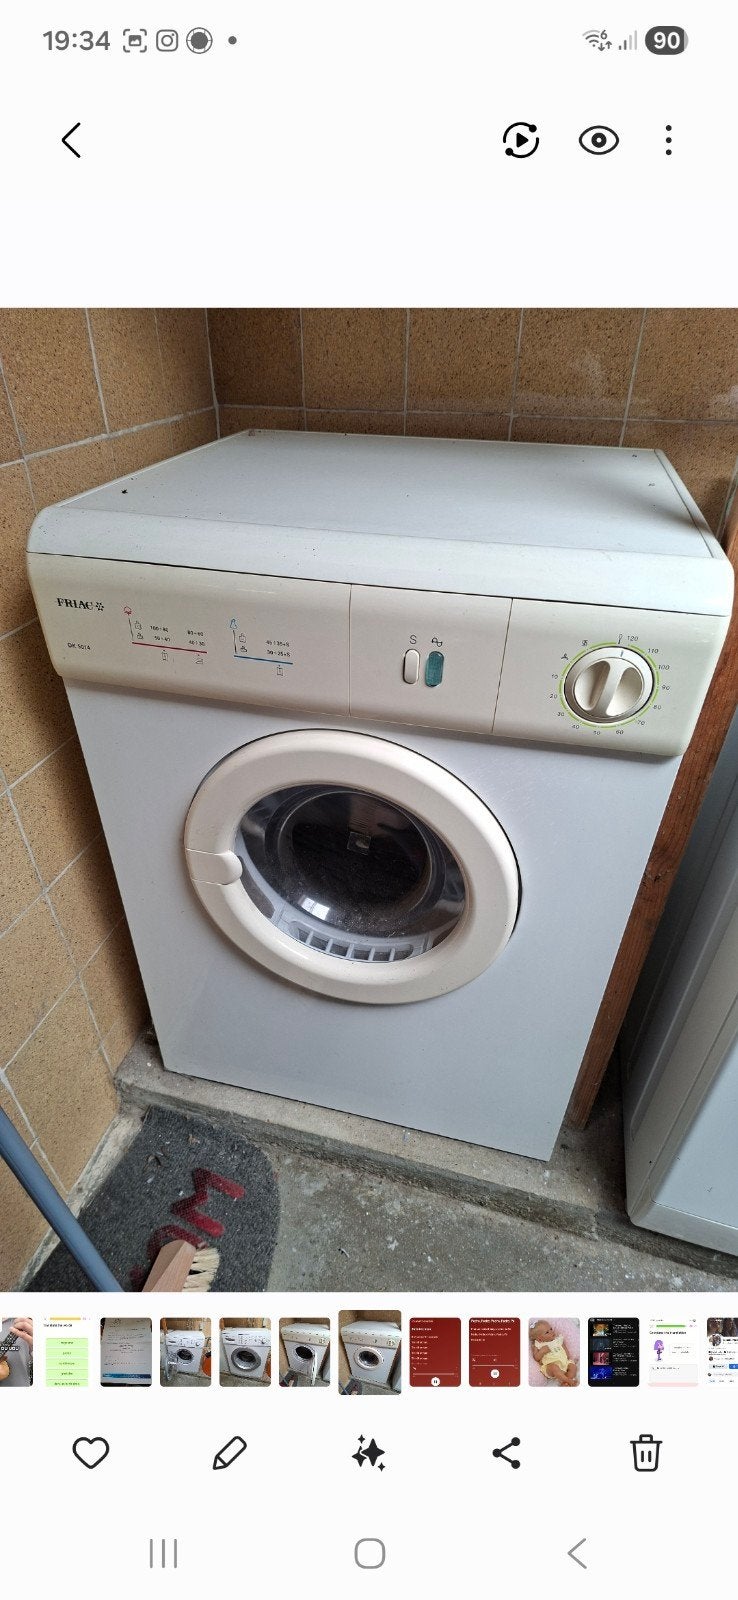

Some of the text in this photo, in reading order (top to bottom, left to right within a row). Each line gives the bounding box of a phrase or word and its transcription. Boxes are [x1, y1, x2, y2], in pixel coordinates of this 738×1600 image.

[43, 30, 110, 51] 19:34
[654, 31, 681, 49] 90
[56, 597, 93, 610] FRIAC
[409, 634, 417, 645] S
